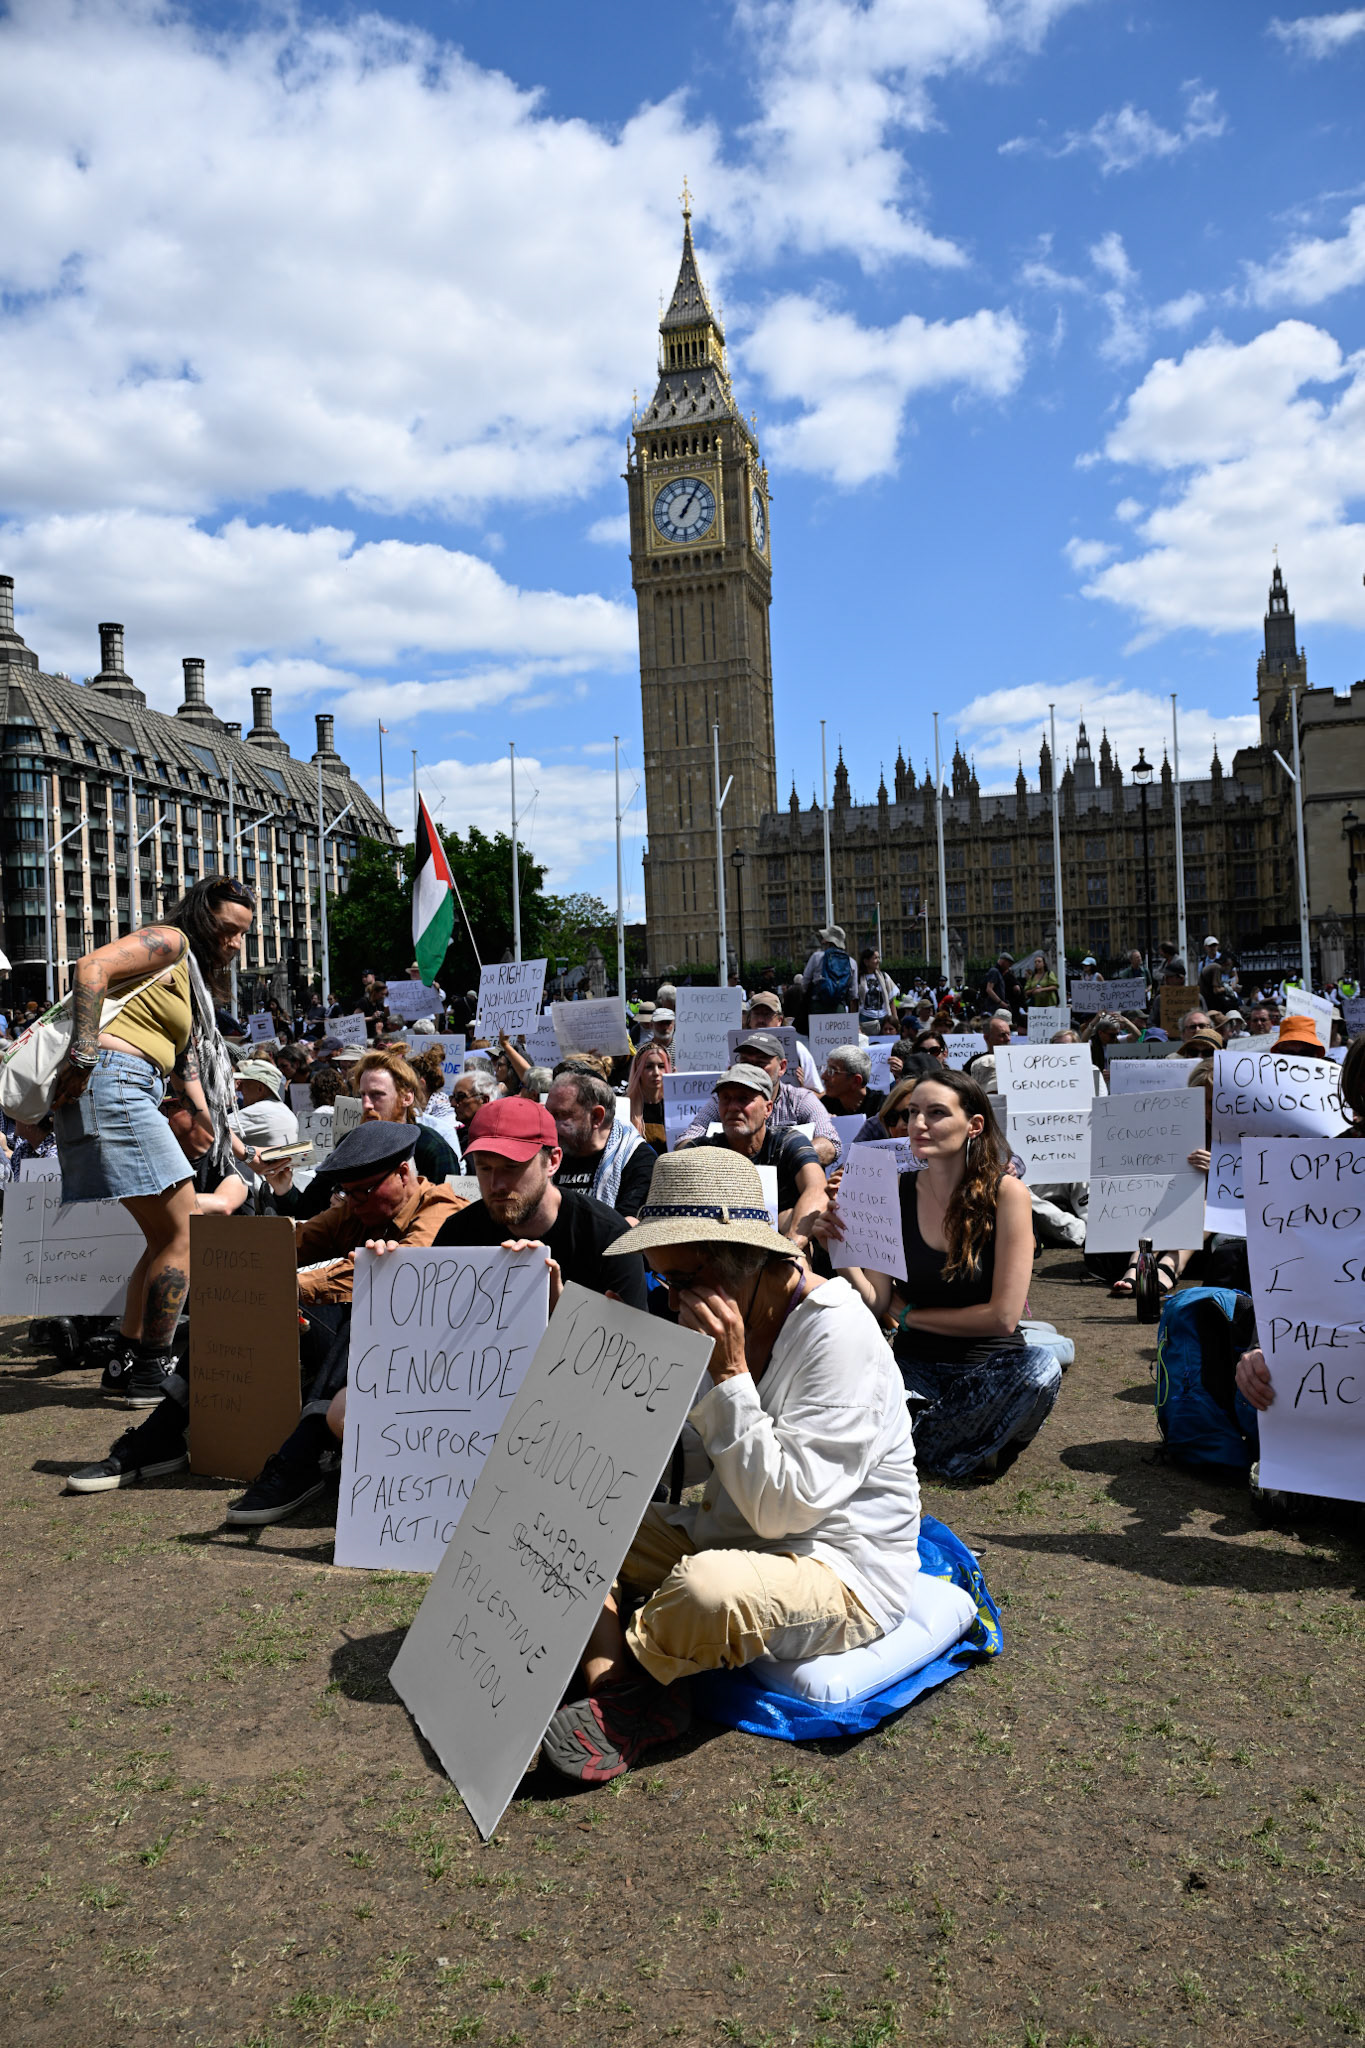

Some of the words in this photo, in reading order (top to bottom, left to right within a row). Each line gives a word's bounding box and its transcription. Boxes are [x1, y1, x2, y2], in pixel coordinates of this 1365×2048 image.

[481, 974, 494, 986] OUR
[498, 964, 529, 986] RIGHT
[532, 968, 542, 980] TO
[1077, 980, 1108, 991] OPPOSE
[484, 987, 538, 1008] NON-VIOLENT
[691, 993, 728, 1002] OPPOSE
[1100, 990, 1136, 1000] SUPPORT
[484, 1009, 532, 1031] PROTEST
[678, 1011, 734, 1023] GENOCIDE
[825, 1020, 851, 1030] OPPOSE
[695, 1032, 728, 1042] SUPPOR
[815, 1036, 853, 1044] GENOCIDE
[678, 1051, 724, 1060] PALESTINE
[1008, 1053, 1013, 1072] I
[1024, 1055, 1082, 1069] OPPOSE
[1218, 1054, 1222, 1088] I
[1234, 1054, 1340, 1088] OPPOSE
[1012, 1079, 1080, 1091] GENOCIDE
[1101, 1102, 1116, 1118] I
[1133, 1096, 1192, 1113] OPPOSE
[305, 1116, 312, 1128] I
[1012, 1116, 1016, 1130] I
[1027, 1114, 1084, 1126] SUPPORT
[1026, 1133, 1084, 1144] PALESTINE
[1107, 1124, 1182, 1141] GENOCIDE
[1031, 1152, 1076, 1162] ACTION
[1098, 1156, 1110, 1169] I
[1120, 1152, 1180, 1167] SUPPORT
[845, 1162, 882, 1178] OPPOSE
[1258, 1150, 1269, 1185] I
[1290, 1151, 1365, 1182] OPPO
[558, 1173, 592, 1184] BLACK
[1100, 1179, 1176, 1196] PALESTINE
[26, 1195, 36, 1212] I
[838, 1190, 888, 1205] NOCIDE
[842, 1208, 893, 1226] SUPPORT
[1099, 1206, 1158, 1222] ACTION
[1262, 1202, 1361, 1234] GENO
[843, 1226, 900, 1247] ALESTINE
[24, 1251, 34, 1264] I
[43, 1248, 98, 1262] SUPPORT
[202, 1248, 264, 1270] OPPOSE
[846, 1241, 896, 1264] ACTION
[26, 1274, 87, 1285] PALESTINE
[1264, 1256, 1304, 1294] I
[194, 1286, 268, 1306] GENOCIDE
[390, 1260, 531, 1330] OPPOSE
[206, 1340, 255, 1368] SUPPORT
[548, 1300, 588, 1376] I
[574, 1326, 684, 1412] OPPOSE
[193, 1366, 255, 1384] PALESTINE
[356, 1344, 528, 1401] GENOCIDE
[194, 1392, 242, 1414] ACTION
[354, 1424, 360, 1473] I
[381, 1424, 500, 1457] SUPPORT
[350, 1474, 476, 1517] PALESTIN
[380, 1514, 456, 1546] ACTIO
[471, 1484, 508, 1535] I
[534, 1512, 606, 1590] SUPPORT
[452, 1550, 547, 1675] PALESTINE
